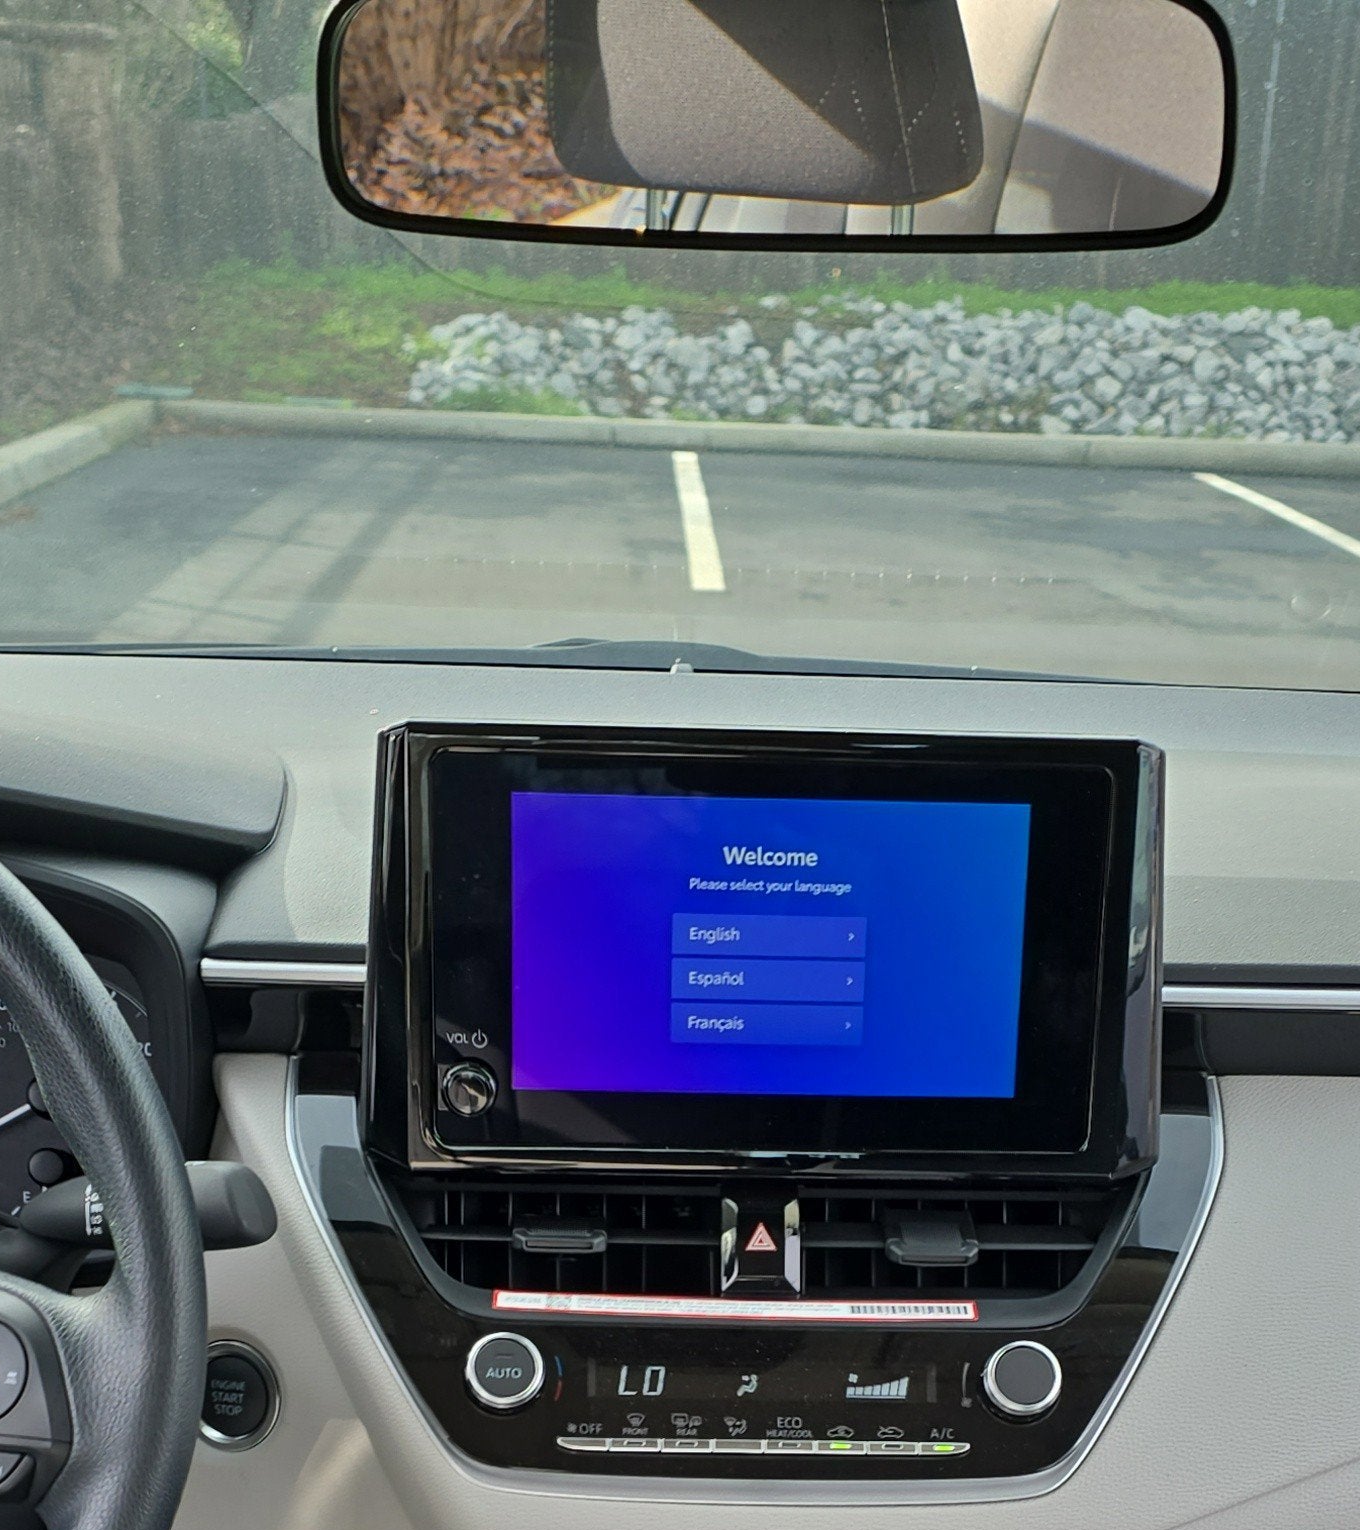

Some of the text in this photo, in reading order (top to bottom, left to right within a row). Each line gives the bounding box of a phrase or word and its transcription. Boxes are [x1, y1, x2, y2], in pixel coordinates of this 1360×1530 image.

[723, 846, 818, 866] Welcome
[689, 877, 851, 897] Please select your language
[689, 925, 740, 944] English
[688, 969, 744, 990] Español
[688, 1014, 744, 1033] Français
[446, 1032, 468, 1044] VOL
[23, 1192, 30, 1203] E
[486, 1365, 523, 1380] AUTO
[211, 1379, 246, 1391] ENGINE
[618, 1365, 665, 1398] LO
[211, 1391, 244, 1403] START
[214, 1404, 242, 1416] STOP
[580, 1423, 602, 1434] OFF
[777, 1417, 802, 1429] ECO
[930, 1428, 954, 1440] A/C
